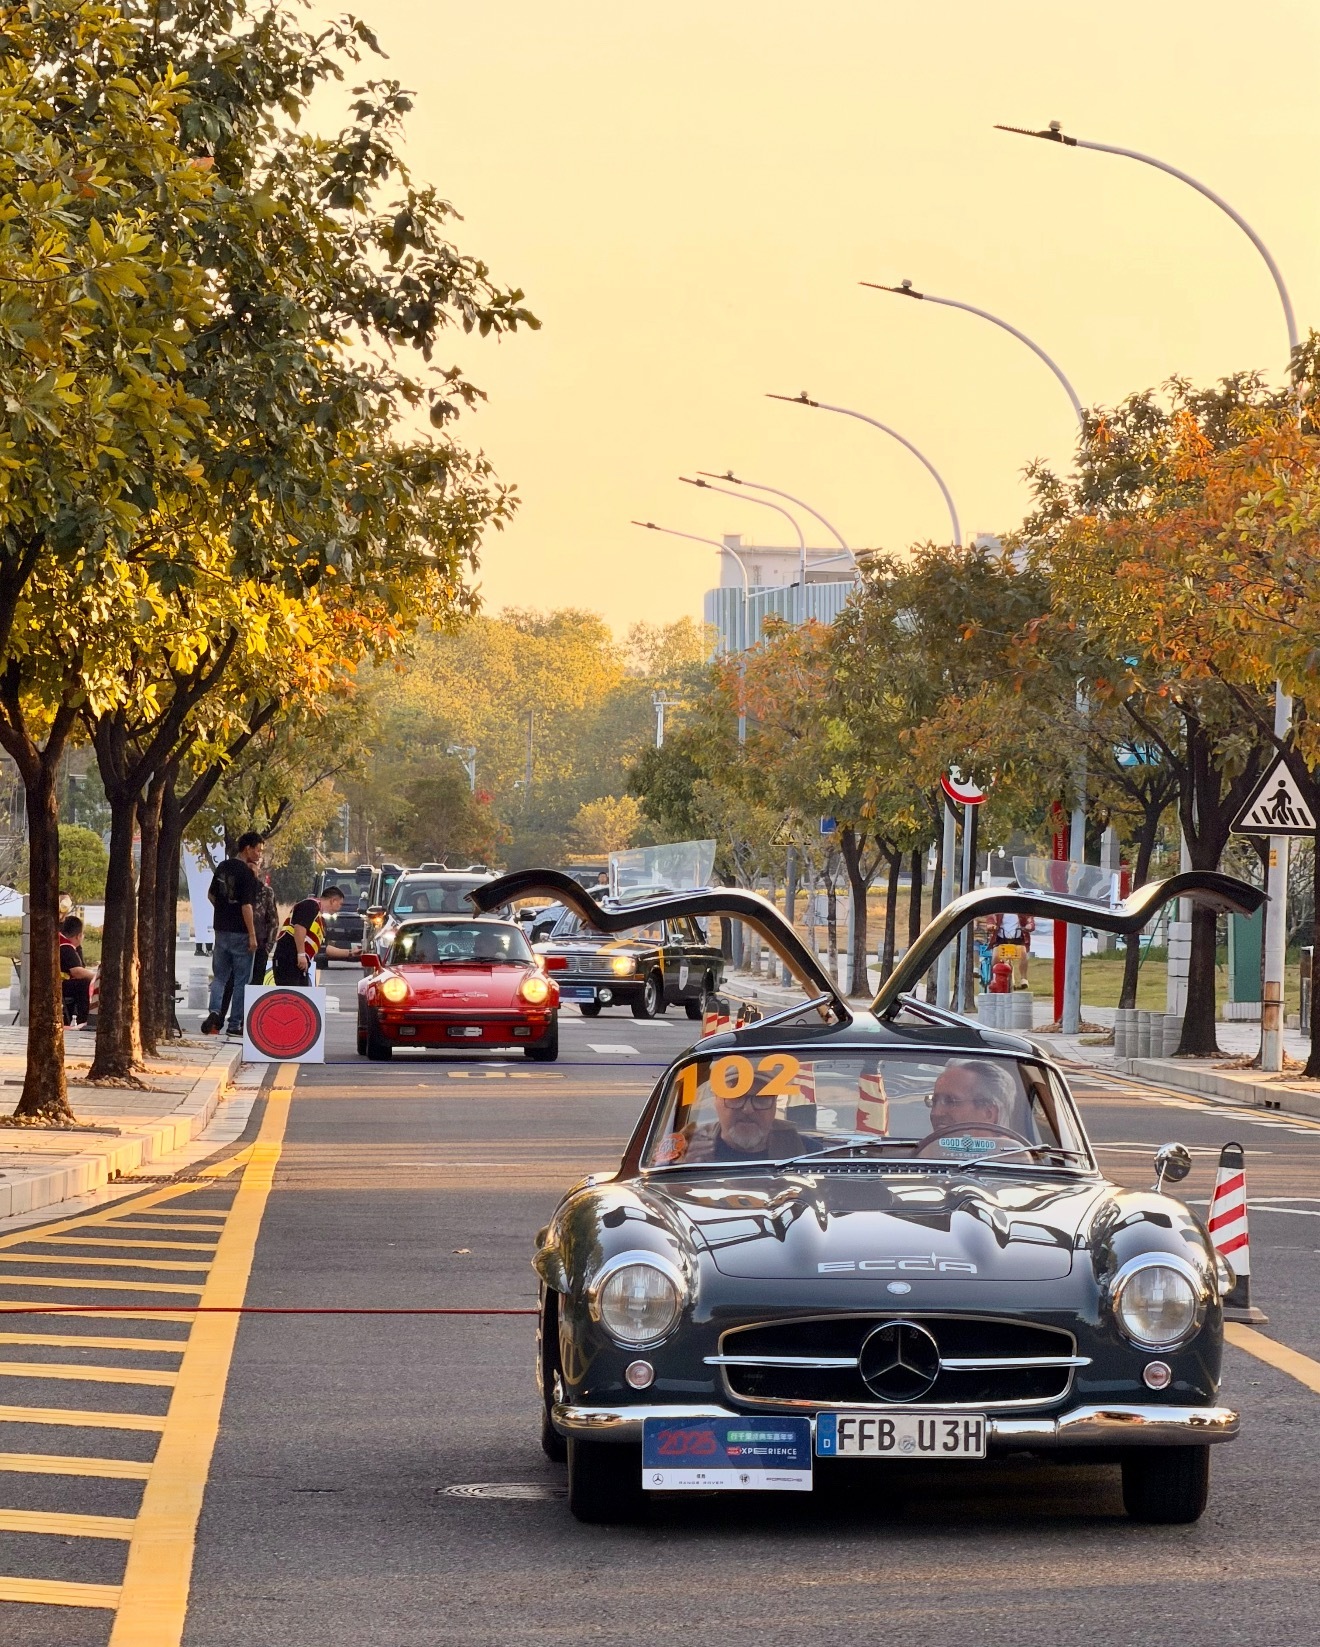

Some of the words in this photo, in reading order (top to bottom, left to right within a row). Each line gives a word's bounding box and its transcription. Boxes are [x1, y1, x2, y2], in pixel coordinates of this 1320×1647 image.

[675, 1053, 801, 1107] 102
[940, 1138, 960, 1147] GOOD
[975, 1140, 995, 1149] WOOD
[817, 1256, 978, 1274] ECCA
[657, 1429, 718, 1456] 2025
[823, 1439, 831, 1448] D
[837, 1418, 896, 1451] FFB
[917, 1419, 982, 1452] U3H
